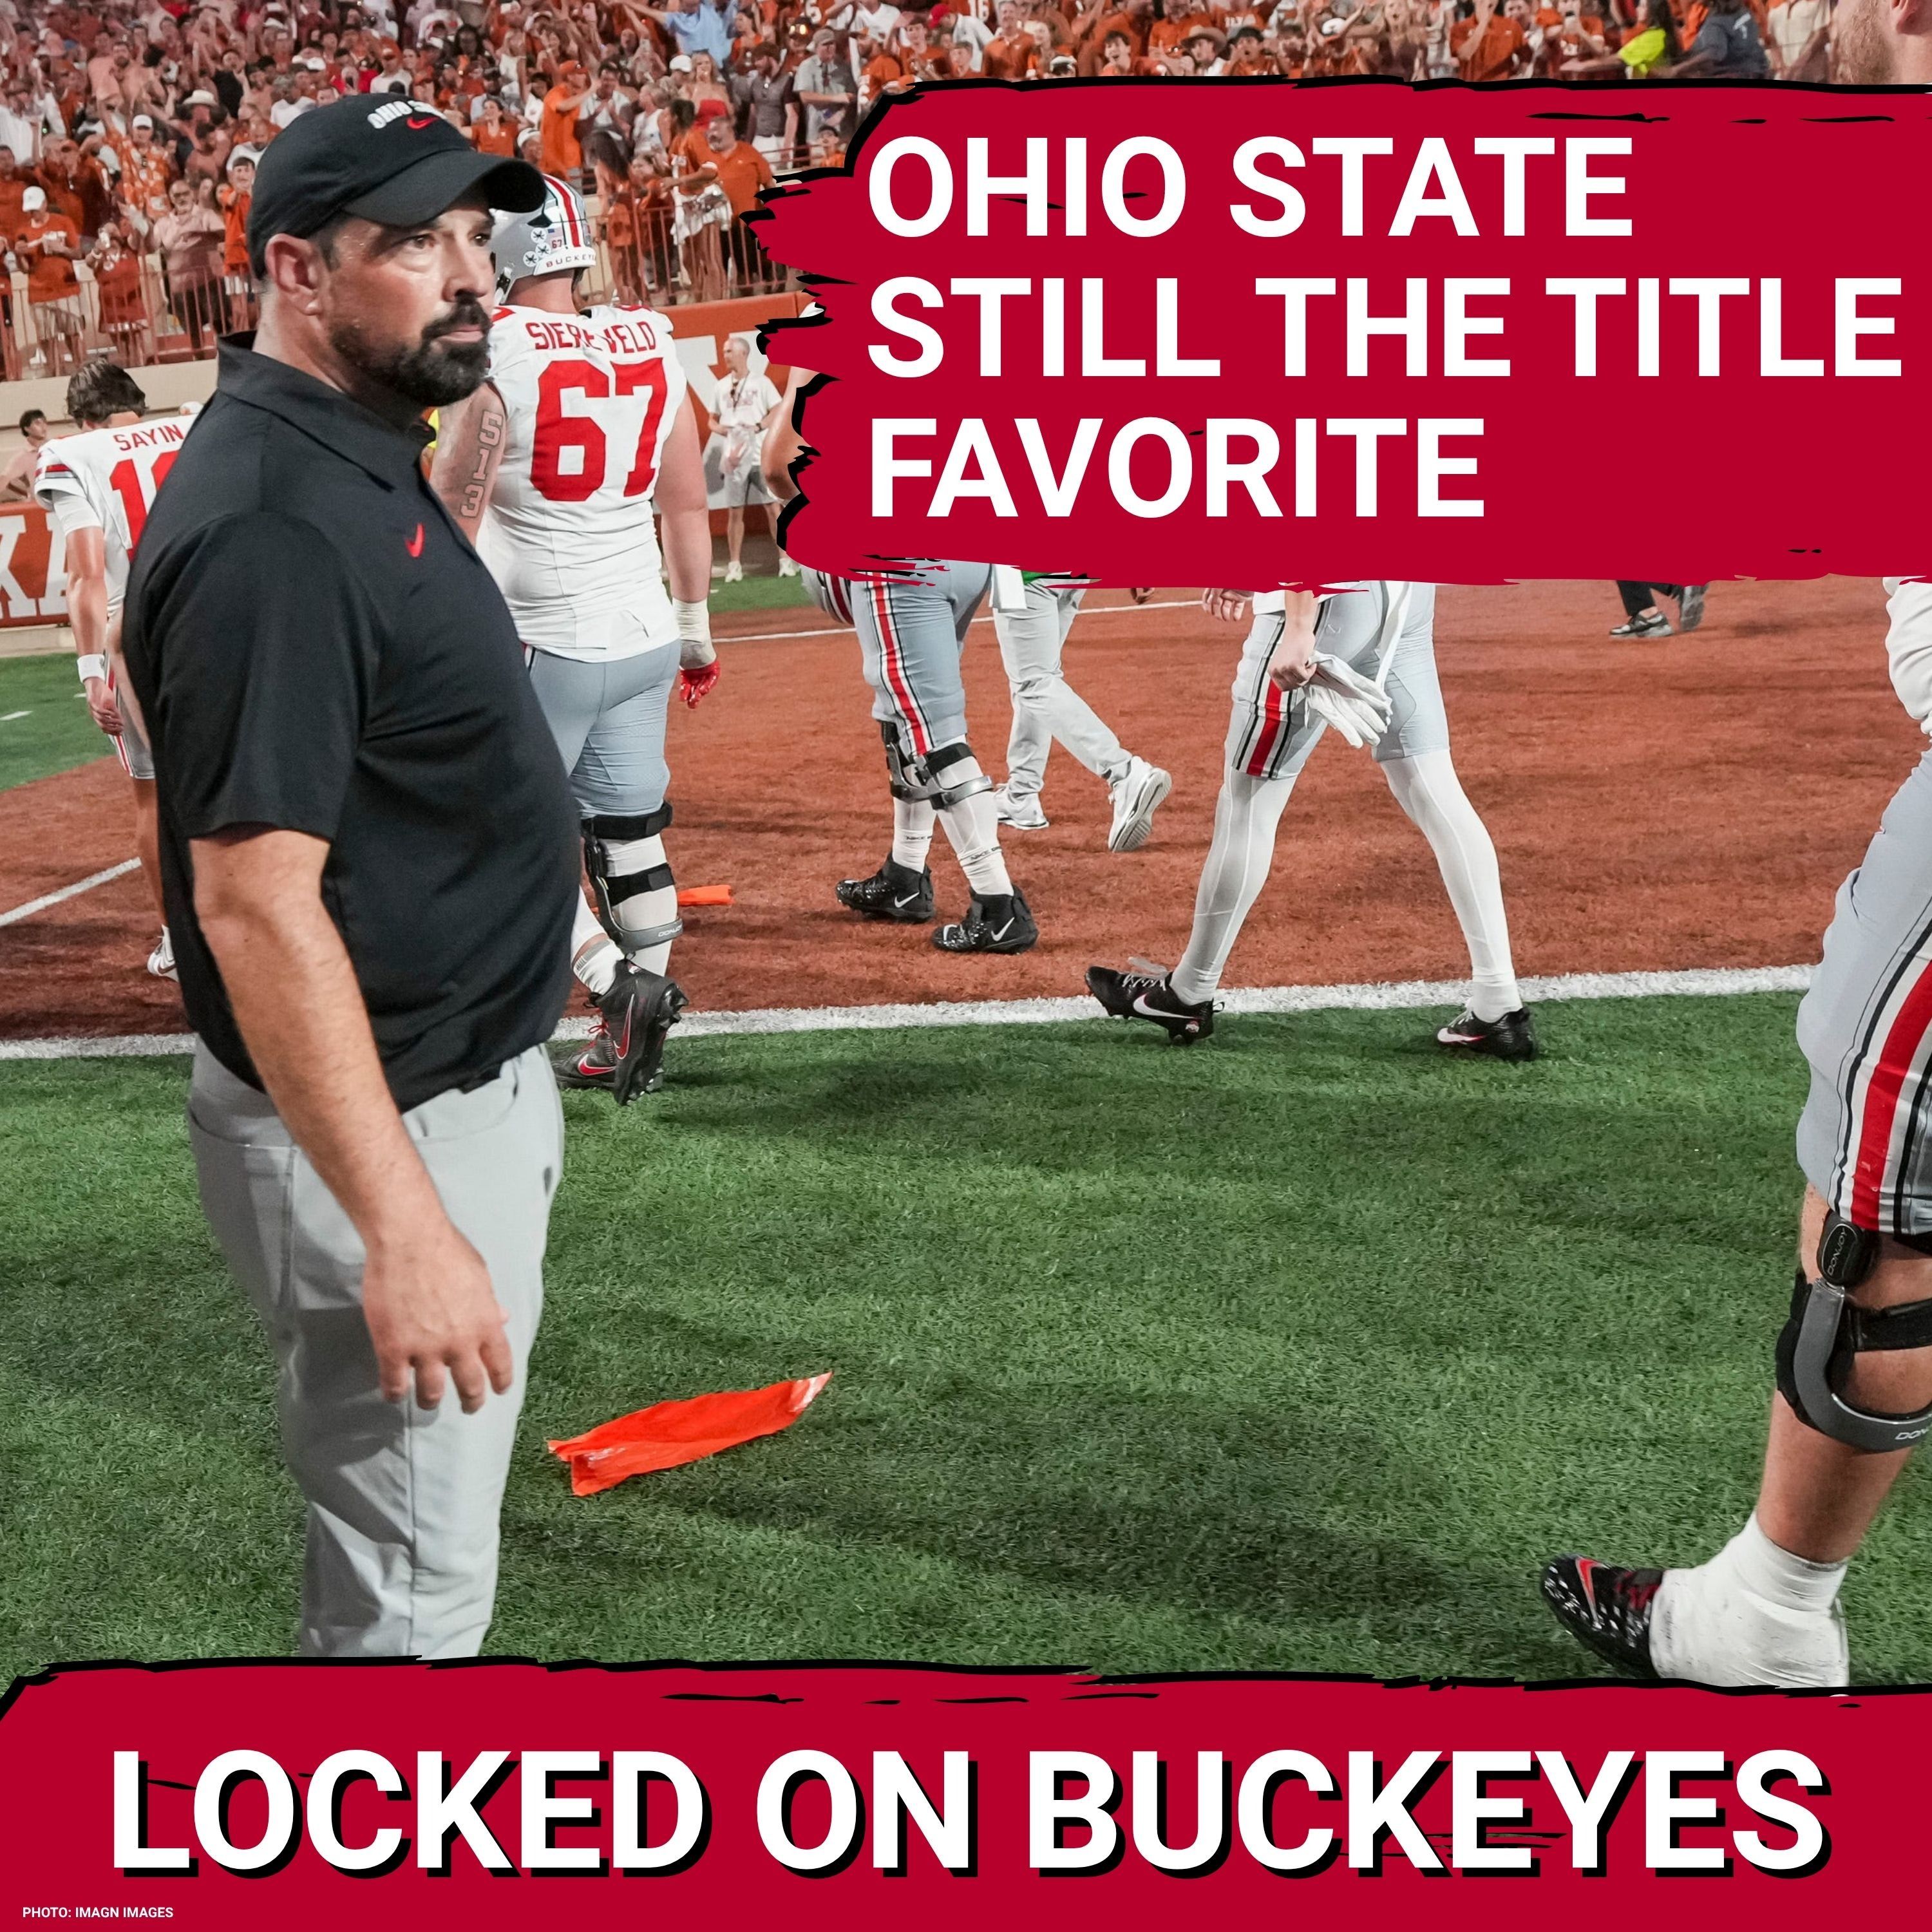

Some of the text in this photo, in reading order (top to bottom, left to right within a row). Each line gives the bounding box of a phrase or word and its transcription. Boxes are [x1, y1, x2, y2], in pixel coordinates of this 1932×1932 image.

[551, 239, 562, 249] 67
[113, 424, 184, 451] SAYIN
[460, 410, 503, 518] 513
[529, 357, 668, 502] 67
[109, 449, 181, 563] 1
[1827, 1226, 1848, 1276] DONJOY
